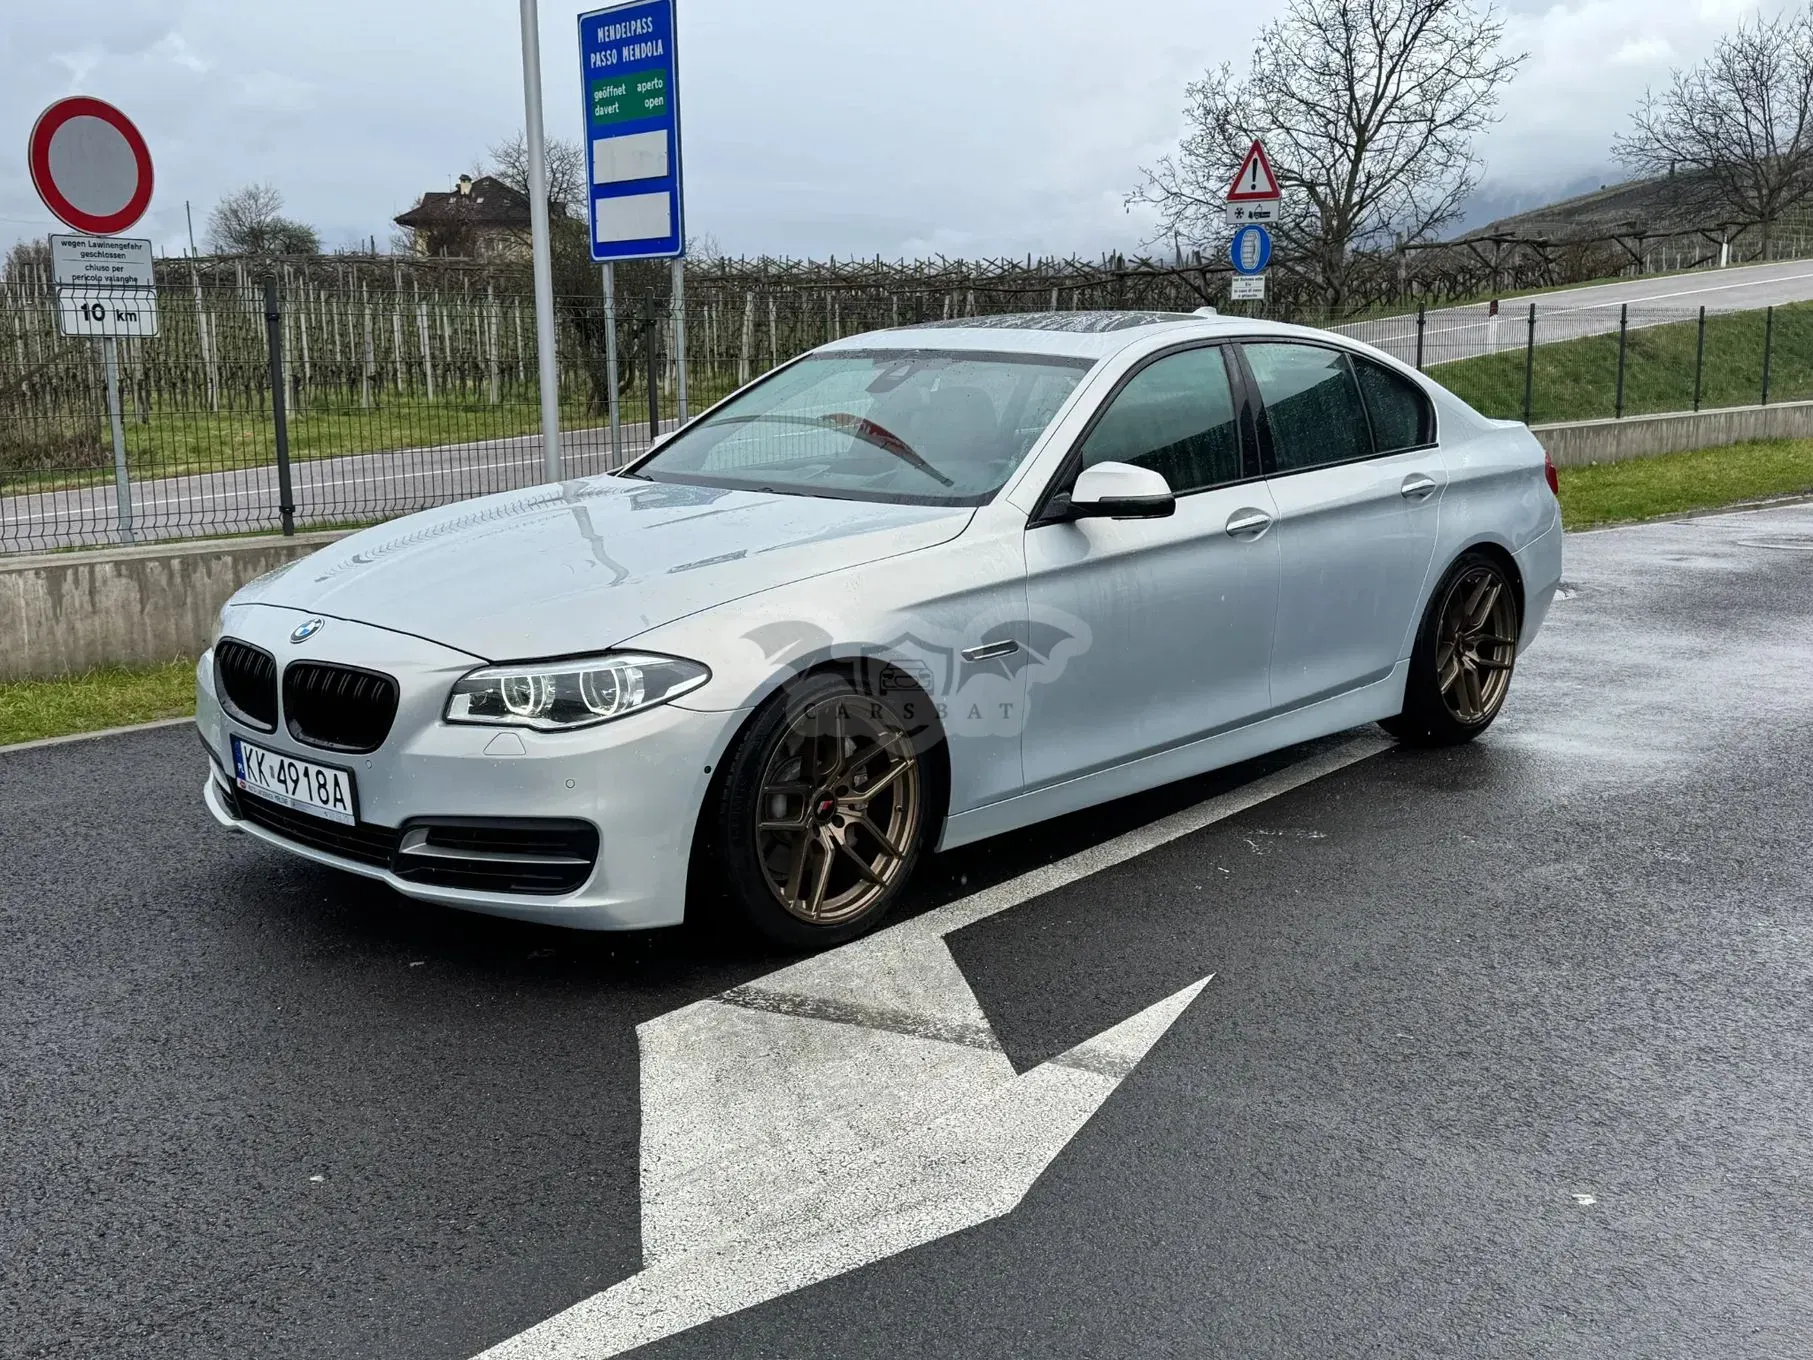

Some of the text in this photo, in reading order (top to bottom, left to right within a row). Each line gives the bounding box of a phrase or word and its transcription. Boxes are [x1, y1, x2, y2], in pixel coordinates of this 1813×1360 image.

[597, 16, 653, 43] MENDELPASS
[590, 39, 664, 69] PASSO MENDOLA
[593, 83, 626, 102] geöffnet
[636, 77, 664, 94] aperto
[594, 101, 620, 116] davert
[644, 96, 664, 109] open
[61, 240, 142, 251] wegen Lawinengefahr
[80, 251, 127, 260] geschlossen
[85, 263, 124, 275] chiuso per
[72, 273, 103, 283] pericolo
[80, 303, 137, 322] 10 km
[243, 745, 271, 788] KK
[276, 758, 348, 811] 4918A
